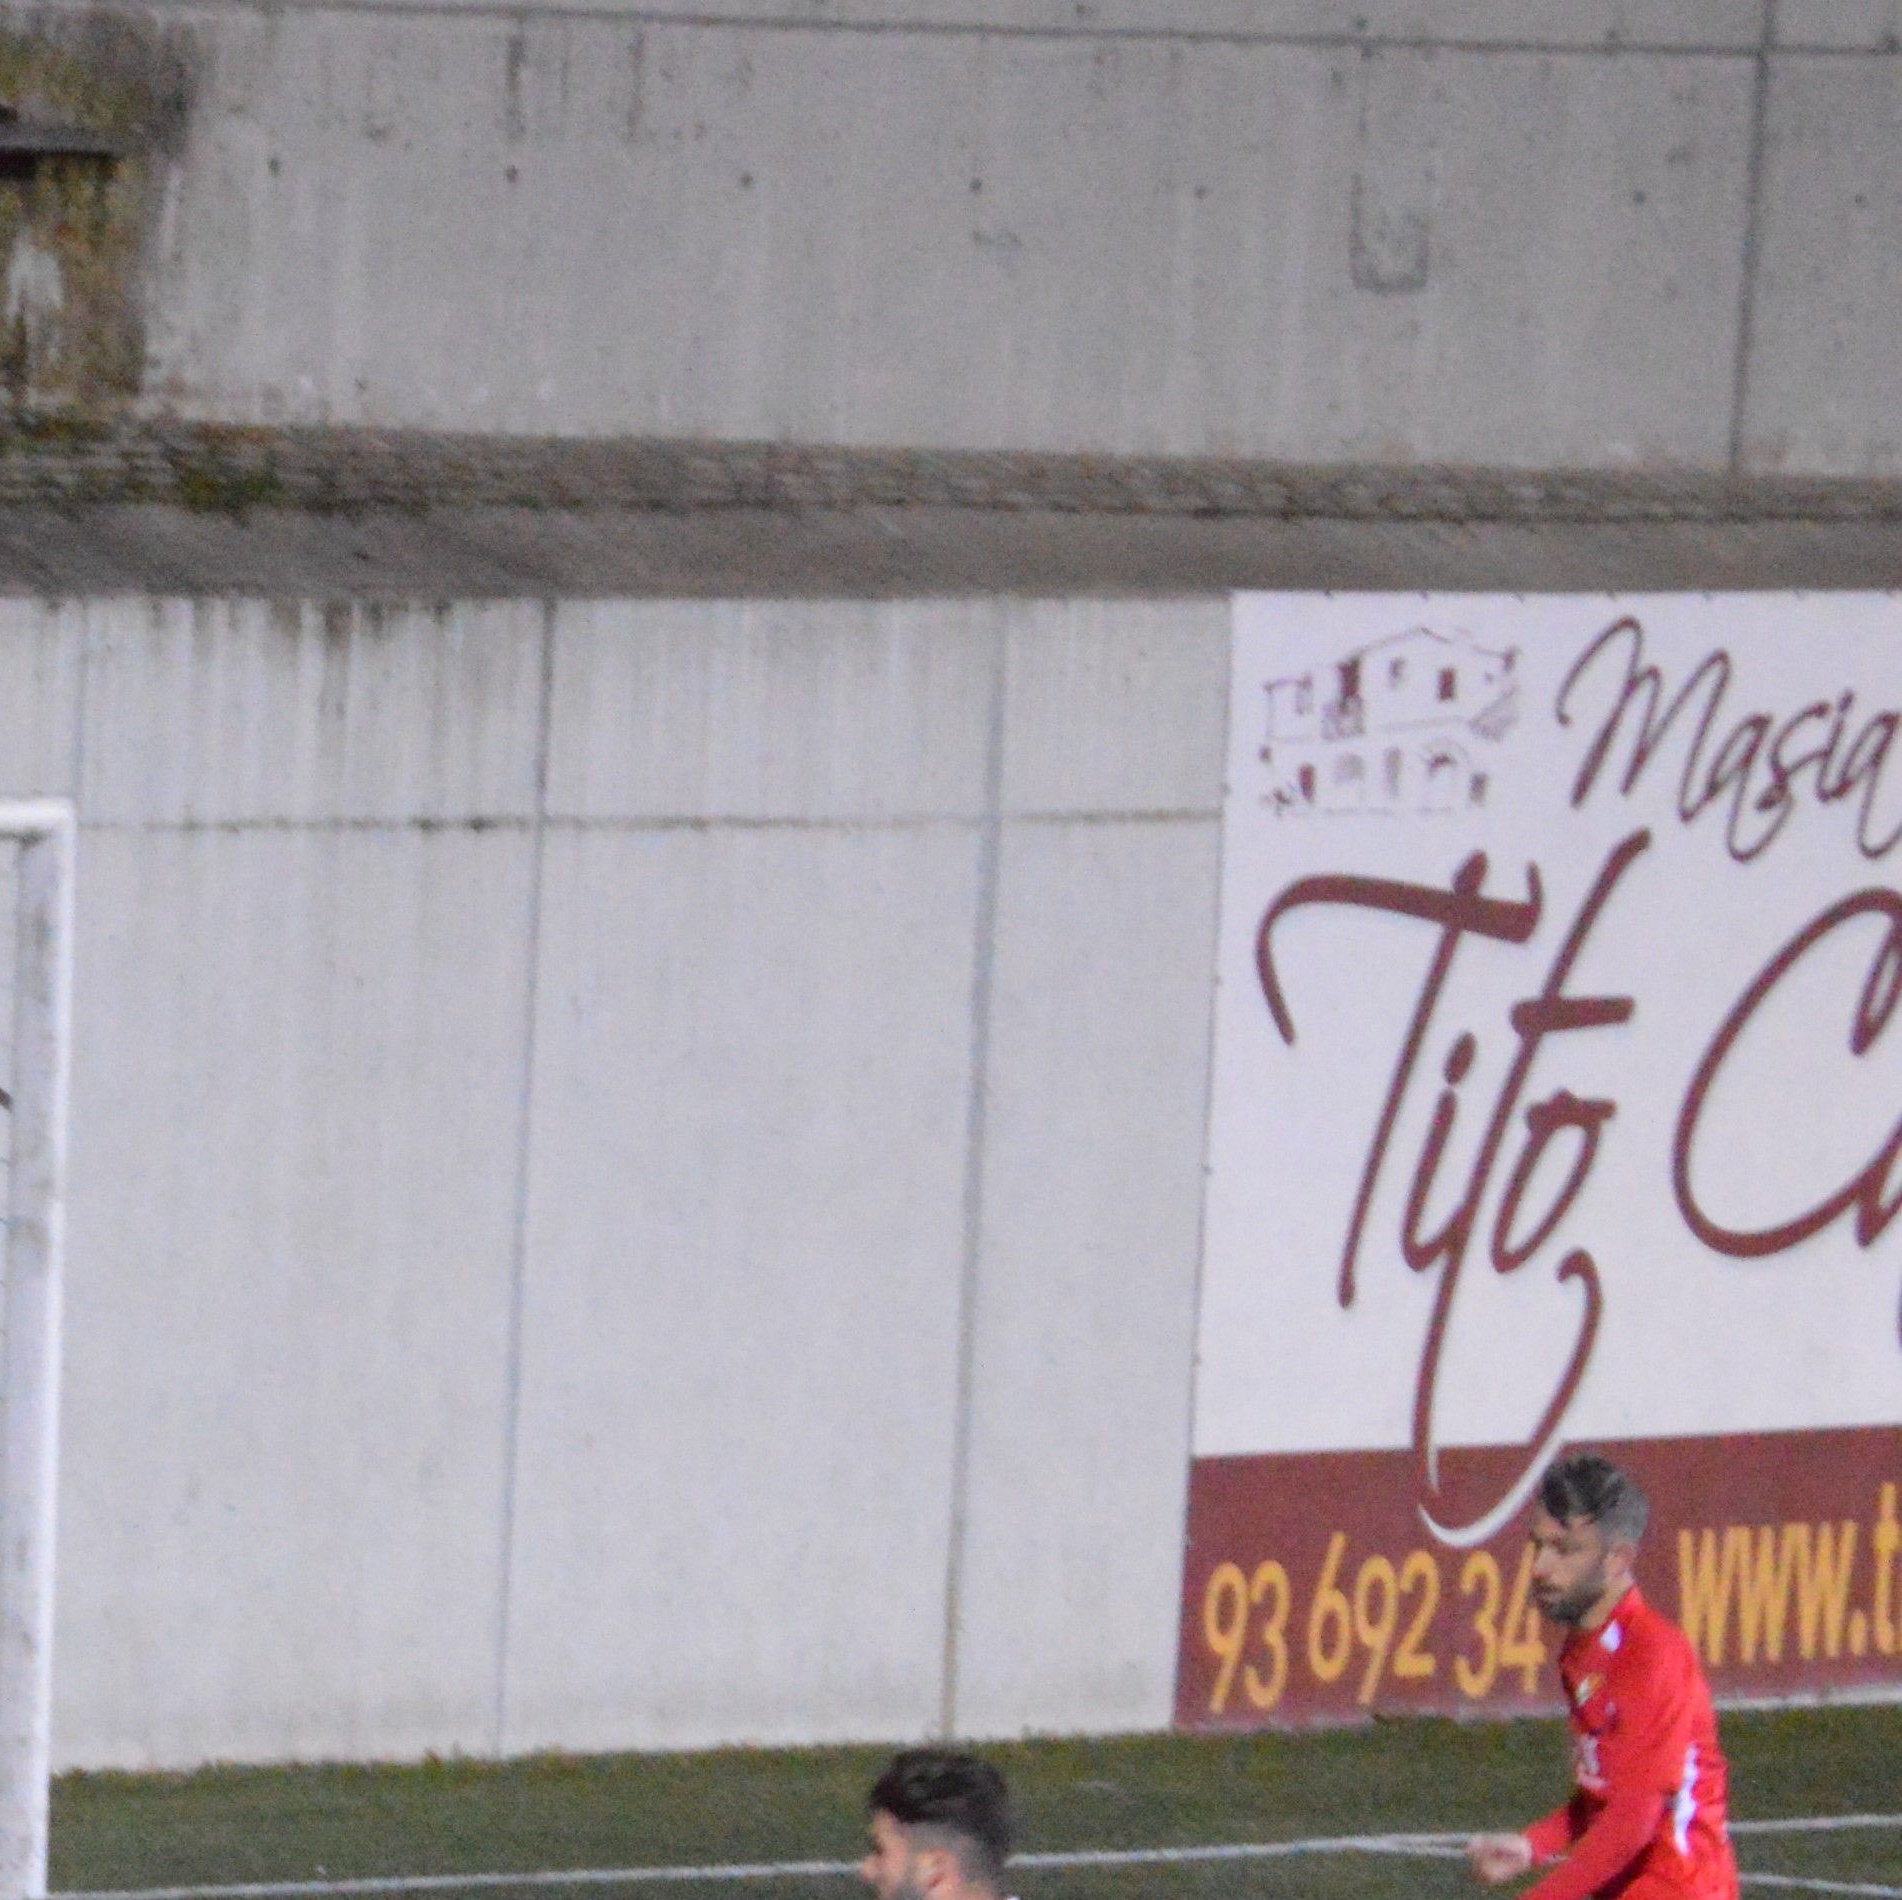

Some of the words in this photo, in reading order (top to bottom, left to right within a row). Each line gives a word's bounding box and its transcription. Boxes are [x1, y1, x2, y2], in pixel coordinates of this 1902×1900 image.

[1671, 886, 1902, 1258] C
[1203, 1560, 1293, 1714] 93
[1308, 1530, 1441, 1706] 692
[1454, 1549, 1546, 1698] 34
[1677, 1481, 1902, 1668] www.t
